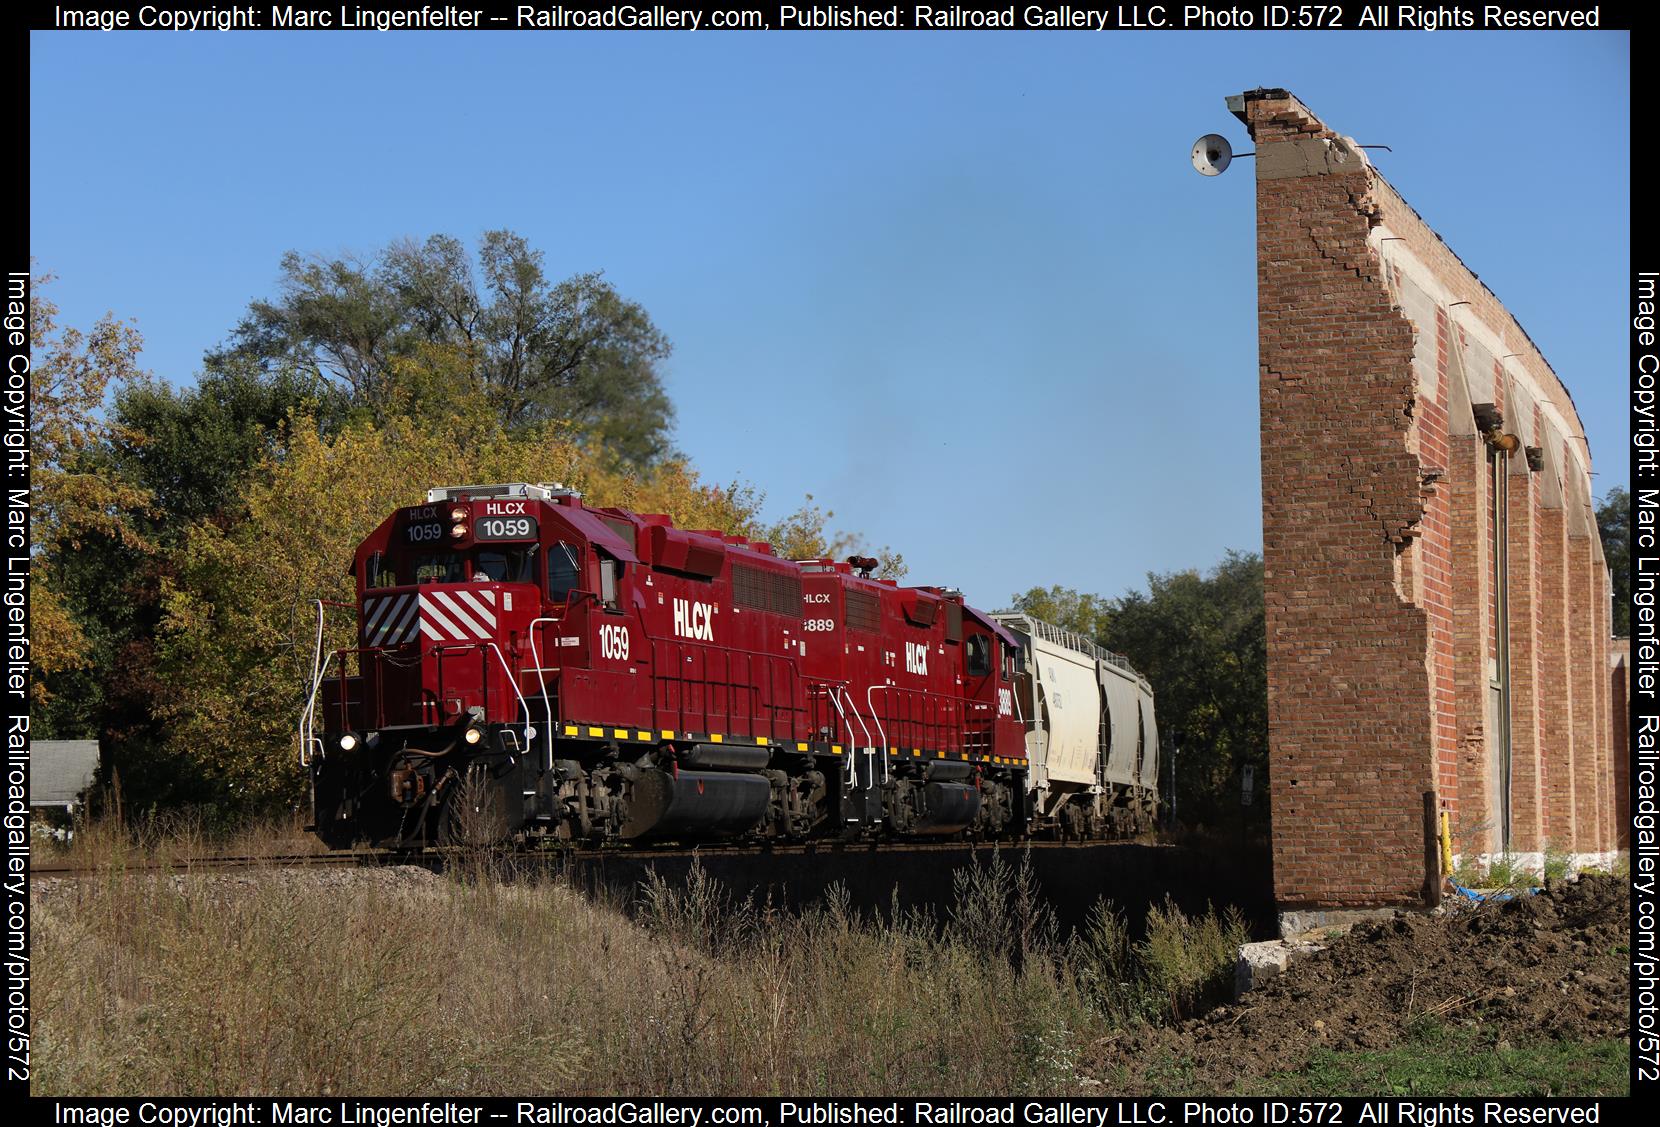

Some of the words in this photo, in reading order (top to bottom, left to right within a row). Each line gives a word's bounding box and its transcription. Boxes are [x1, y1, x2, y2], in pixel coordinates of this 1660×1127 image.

[410, 507, 438, 520] HLCX
[486, 502, 526, 515] HLCX
[407, 523, 442, 541] 1059
[483, 519, 530, 536] 1059
[673, 597, 714, 641] HLCX
[599, 624, 630, 661] 1059
[905, 641, 928, 676] HLCX
